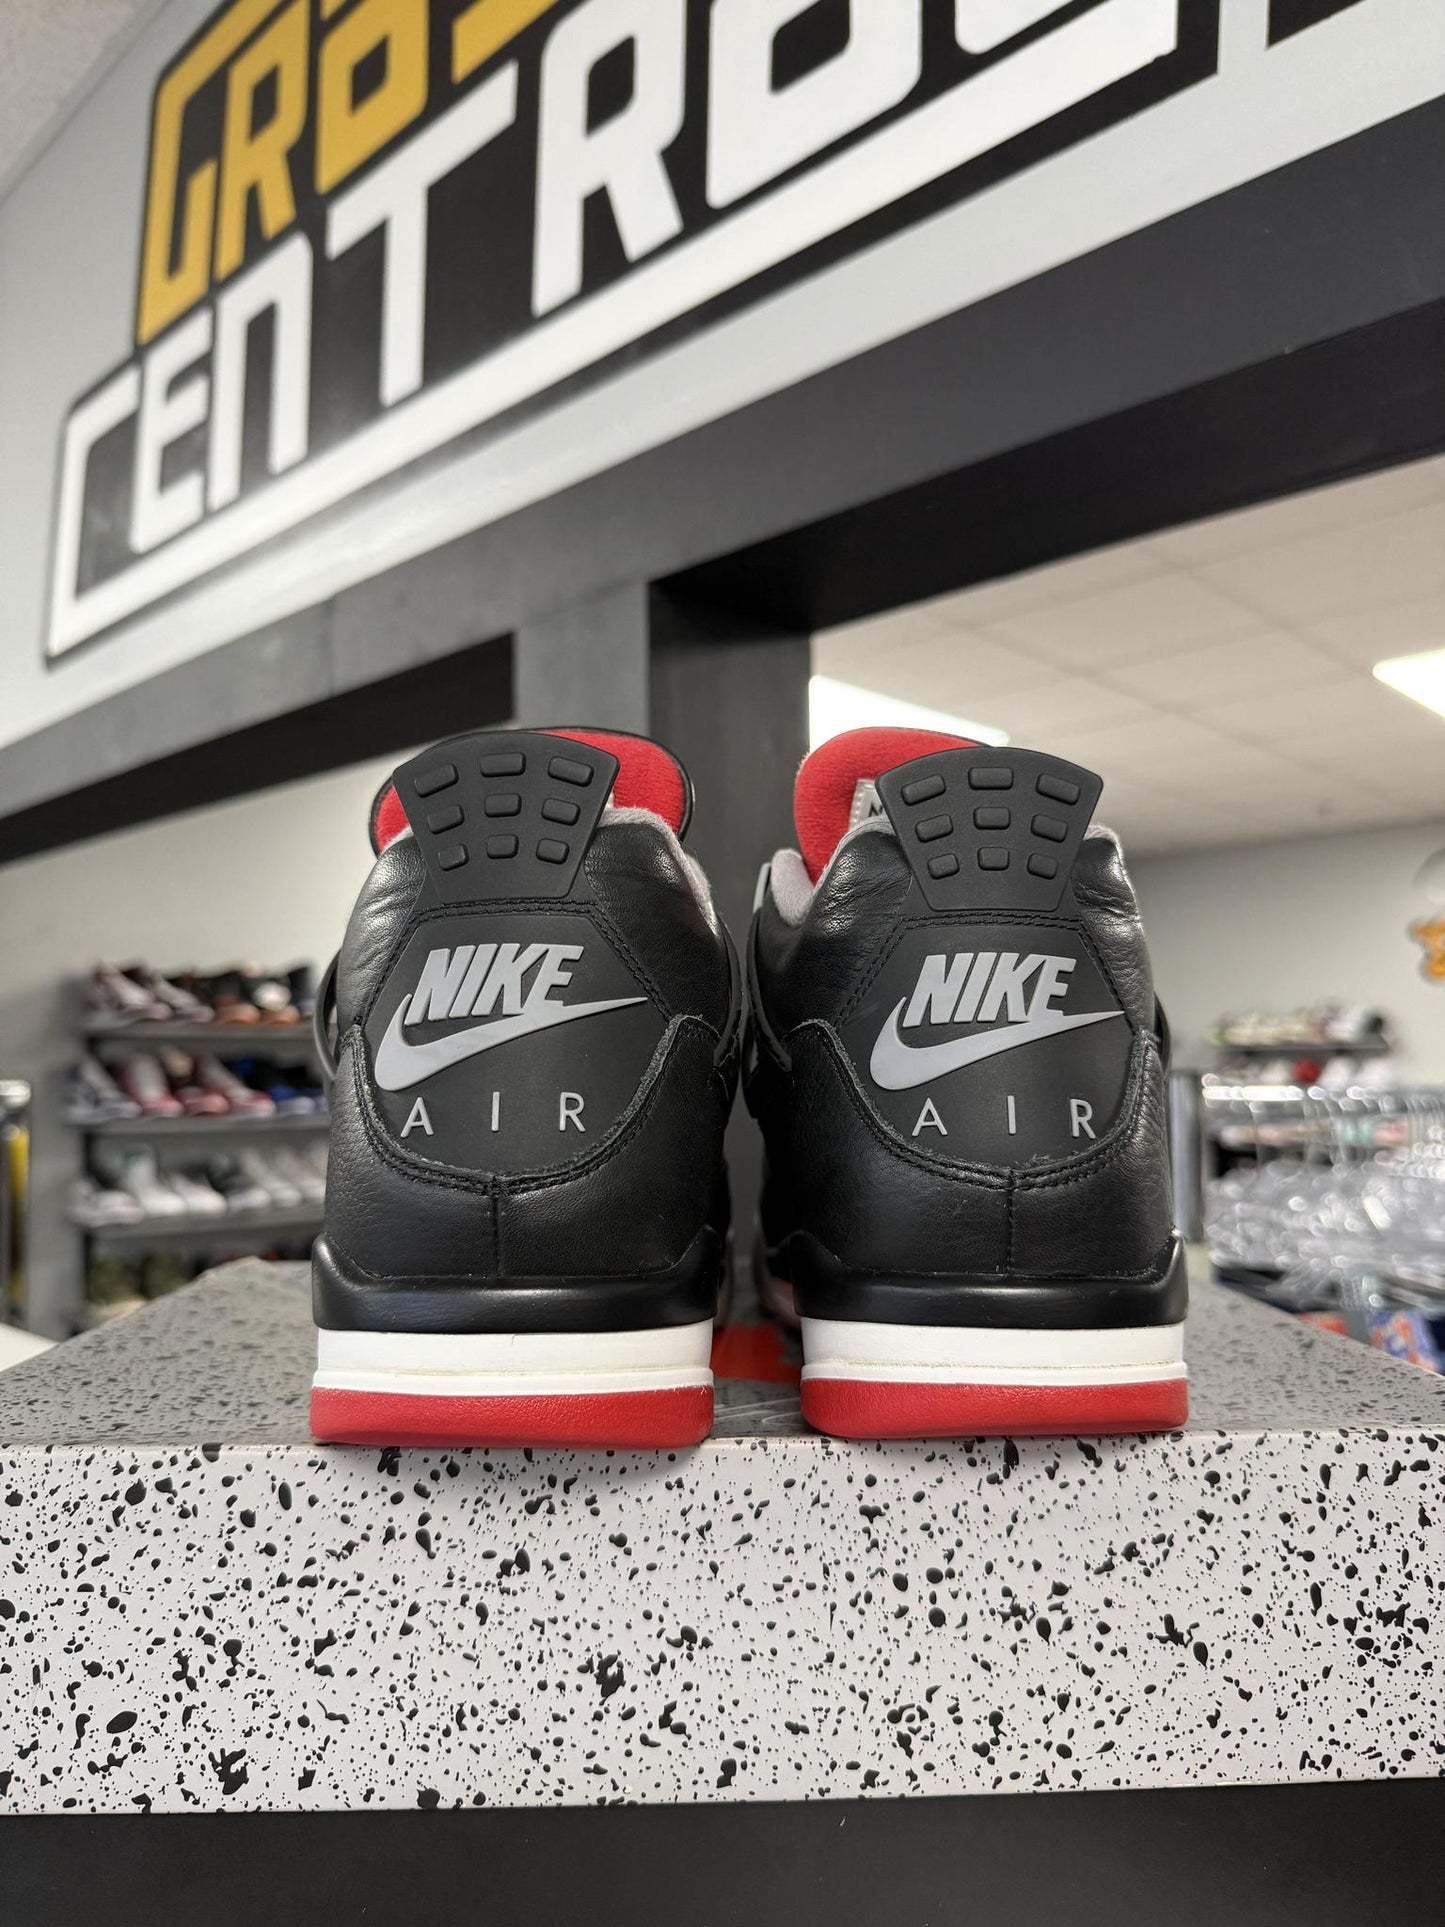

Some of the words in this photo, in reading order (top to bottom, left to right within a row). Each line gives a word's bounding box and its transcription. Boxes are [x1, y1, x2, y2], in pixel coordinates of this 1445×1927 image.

[404, 943, 585, 1026] NIKE
[902, 952, 1077, 1028] NIKE
[400, 1091, 586, 1138] AIR
[911, 1095, 1096, 1139] AIR
